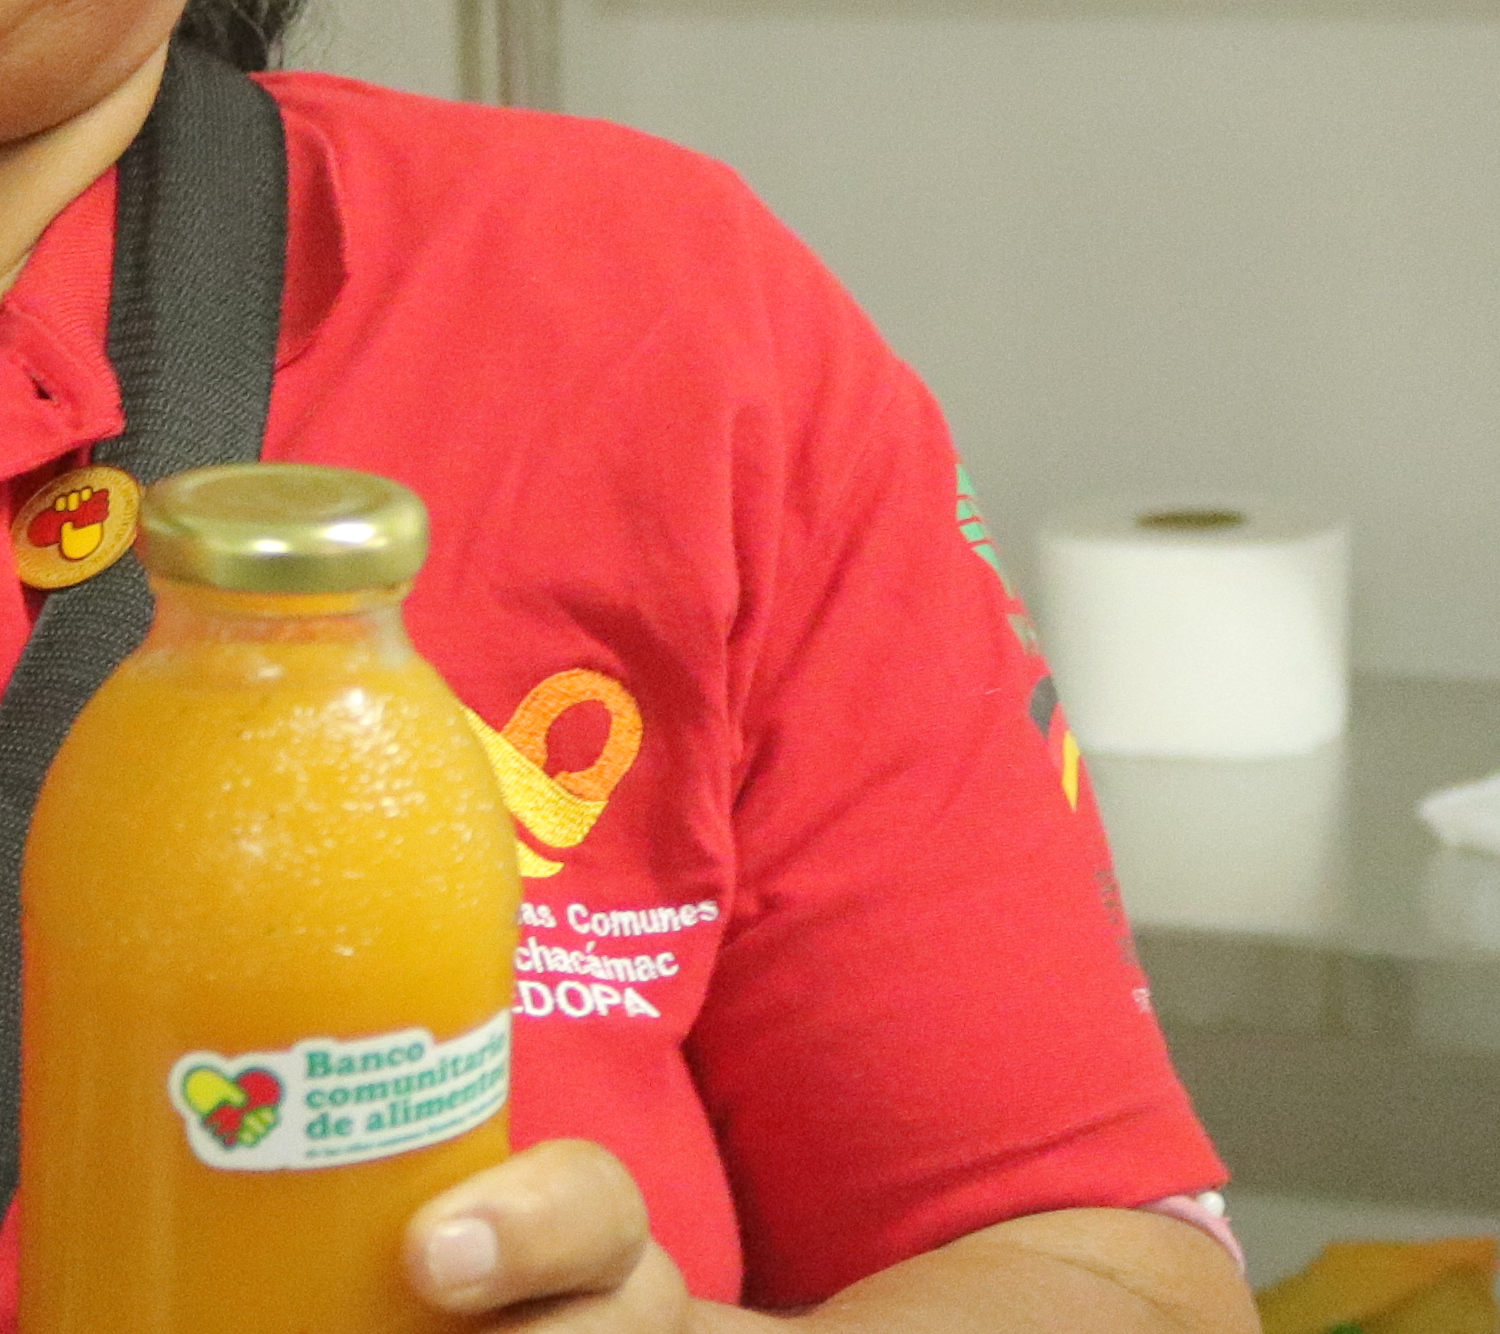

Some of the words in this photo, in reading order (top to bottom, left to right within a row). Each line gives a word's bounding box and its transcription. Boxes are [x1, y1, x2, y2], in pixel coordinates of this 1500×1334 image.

[566, 899, 719, 937] Comunes
[511, 980, 662, 1018] DOPA
[306, 1041, 425, 1079] Banco
[305, 1111, 354, 1140] de
